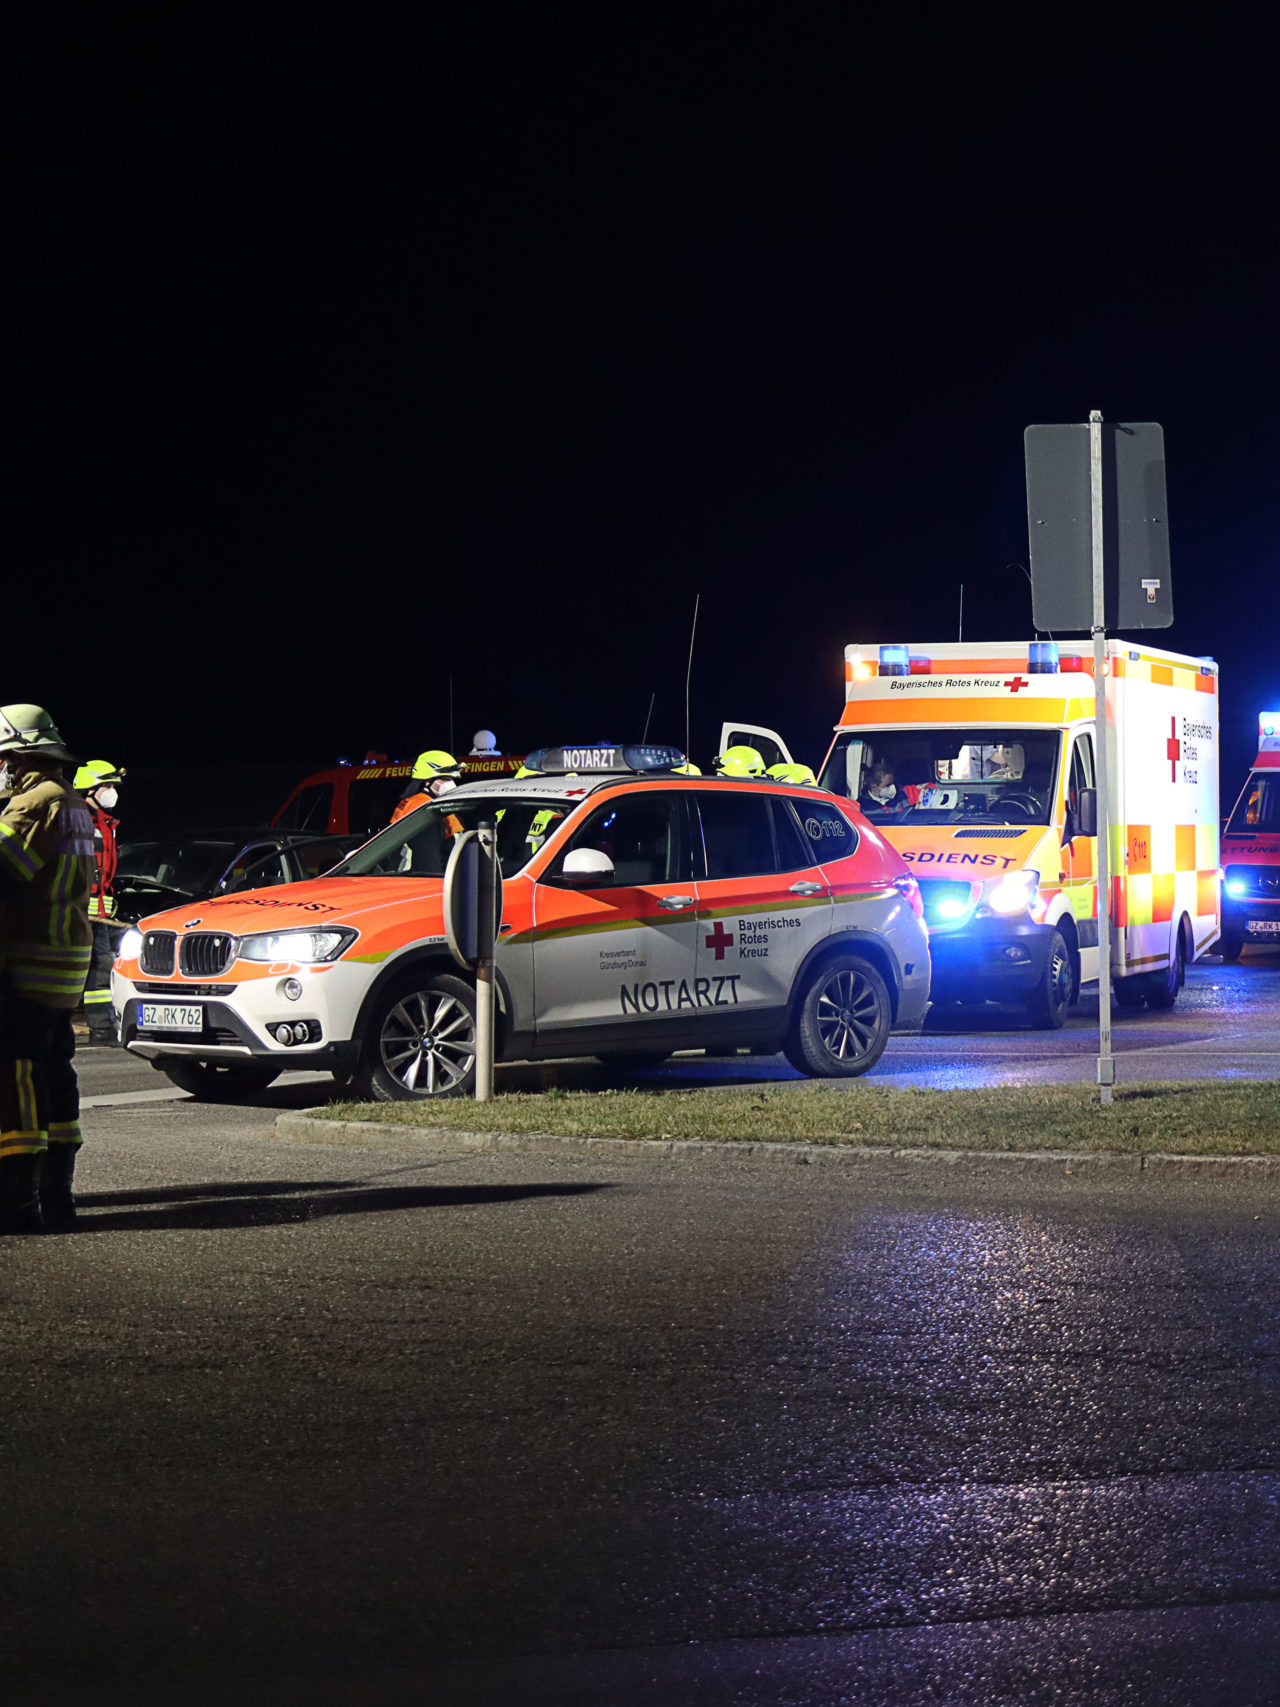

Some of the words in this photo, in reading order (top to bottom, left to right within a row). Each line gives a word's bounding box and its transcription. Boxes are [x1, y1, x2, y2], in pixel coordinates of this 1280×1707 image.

[890, 679, 943, 690] Bayerisches
[945, 678, 971, 688] Rotes
[974, 678, 1000, 687] Kreuz
[466, 761, 504, 772] FINGEN
[563, 749, 615, 768] NOTARZT
[821, 820, 846, 837] 112
[1137, 840, 1147, 859] 112
[901, 851, 1018, 870] SDIENST
[738, 917, 801, 934] Bayerisches
[739, 933, 769, 945] Rotes
[739, 947, 769, 959] Kreuz
[620, 974, 741, 1015] NOTARZT
[144, 1007, 157, 1024] GZ
[163, 1007, 178, 1025] RK
[180, 1008, 201, 1025] 762
